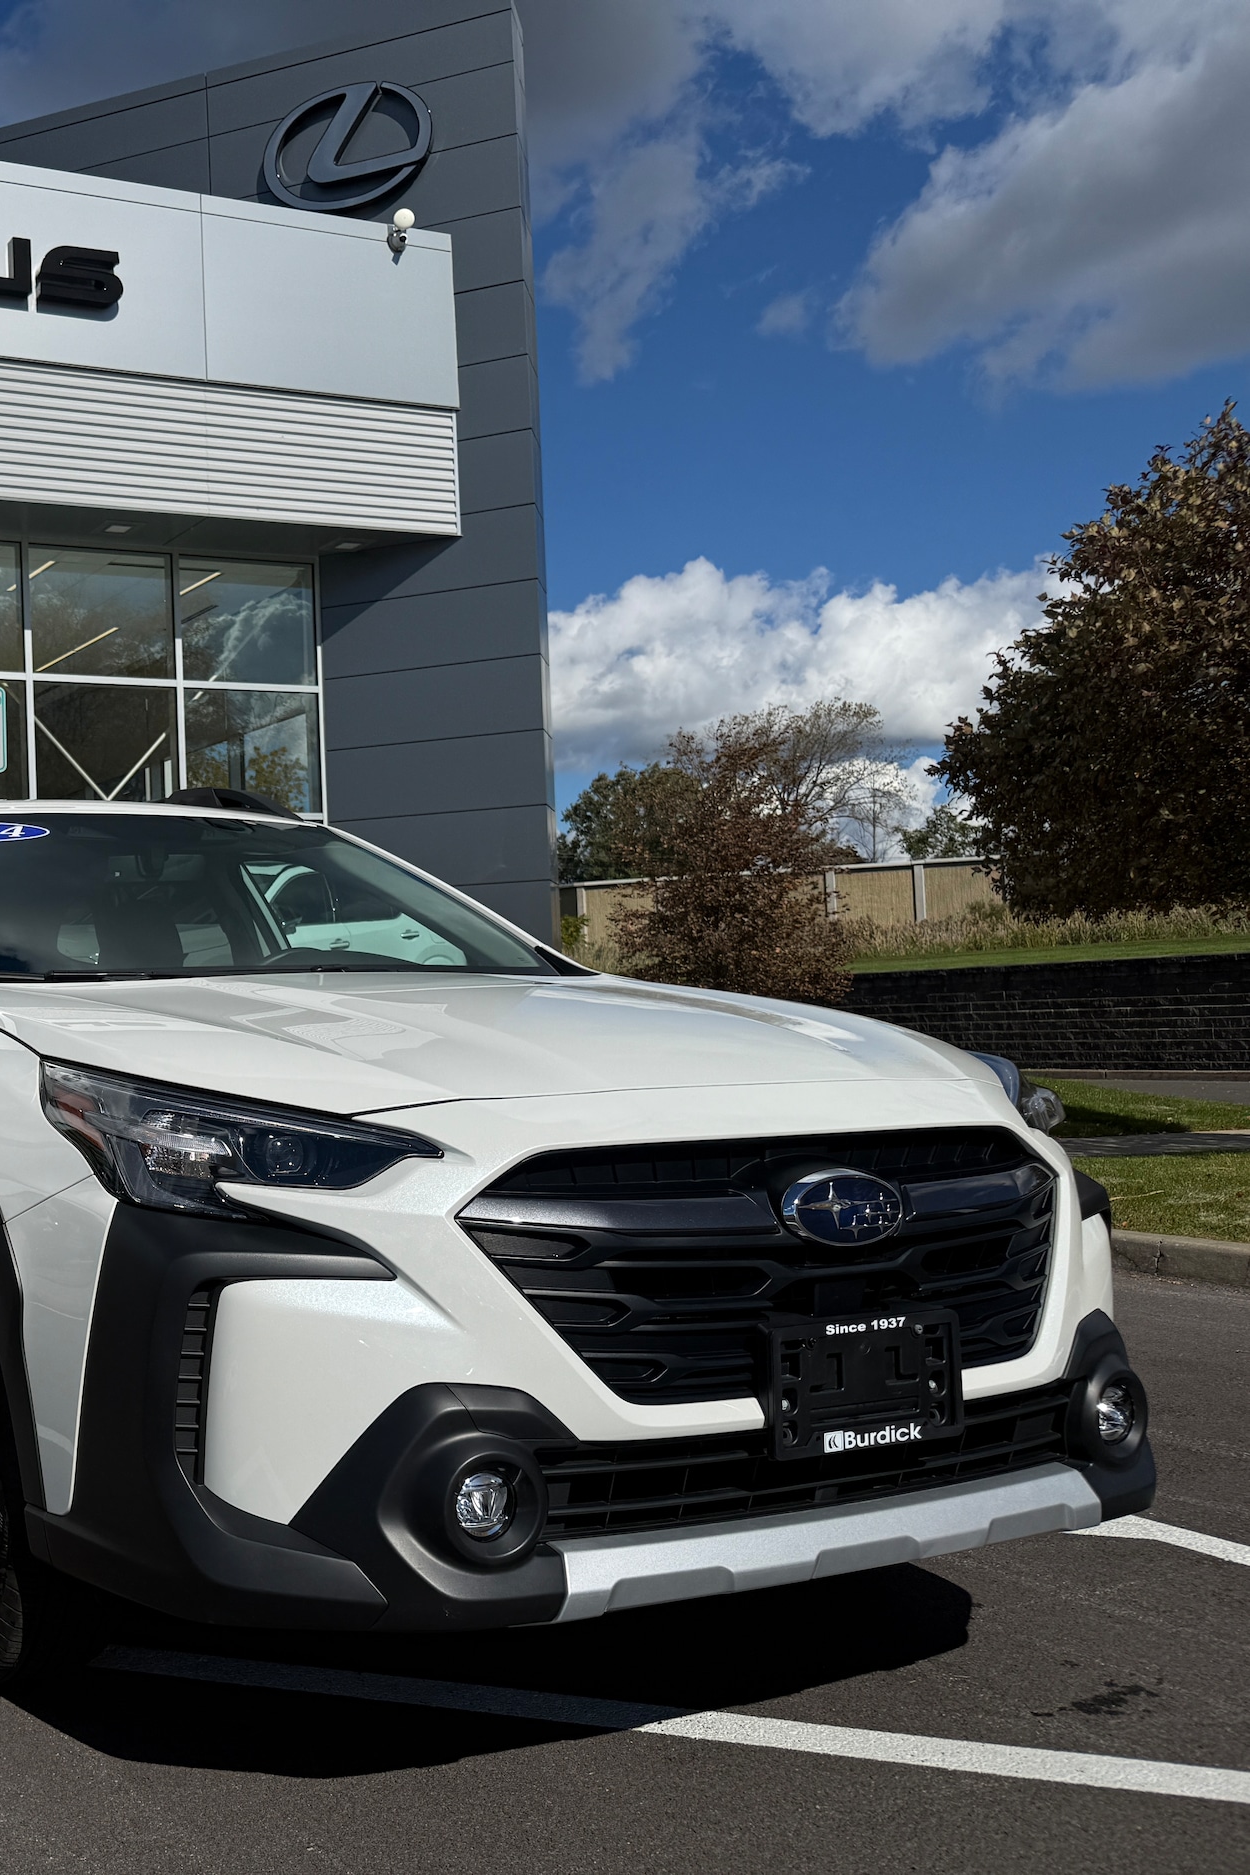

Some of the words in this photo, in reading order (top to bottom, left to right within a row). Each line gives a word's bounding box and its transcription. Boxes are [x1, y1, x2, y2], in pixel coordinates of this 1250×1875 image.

[825, 1322, 867, 1336] Since
[871, 1316, 906, 1331] 1937
[844, 1423, 922, 1450] Burdick
